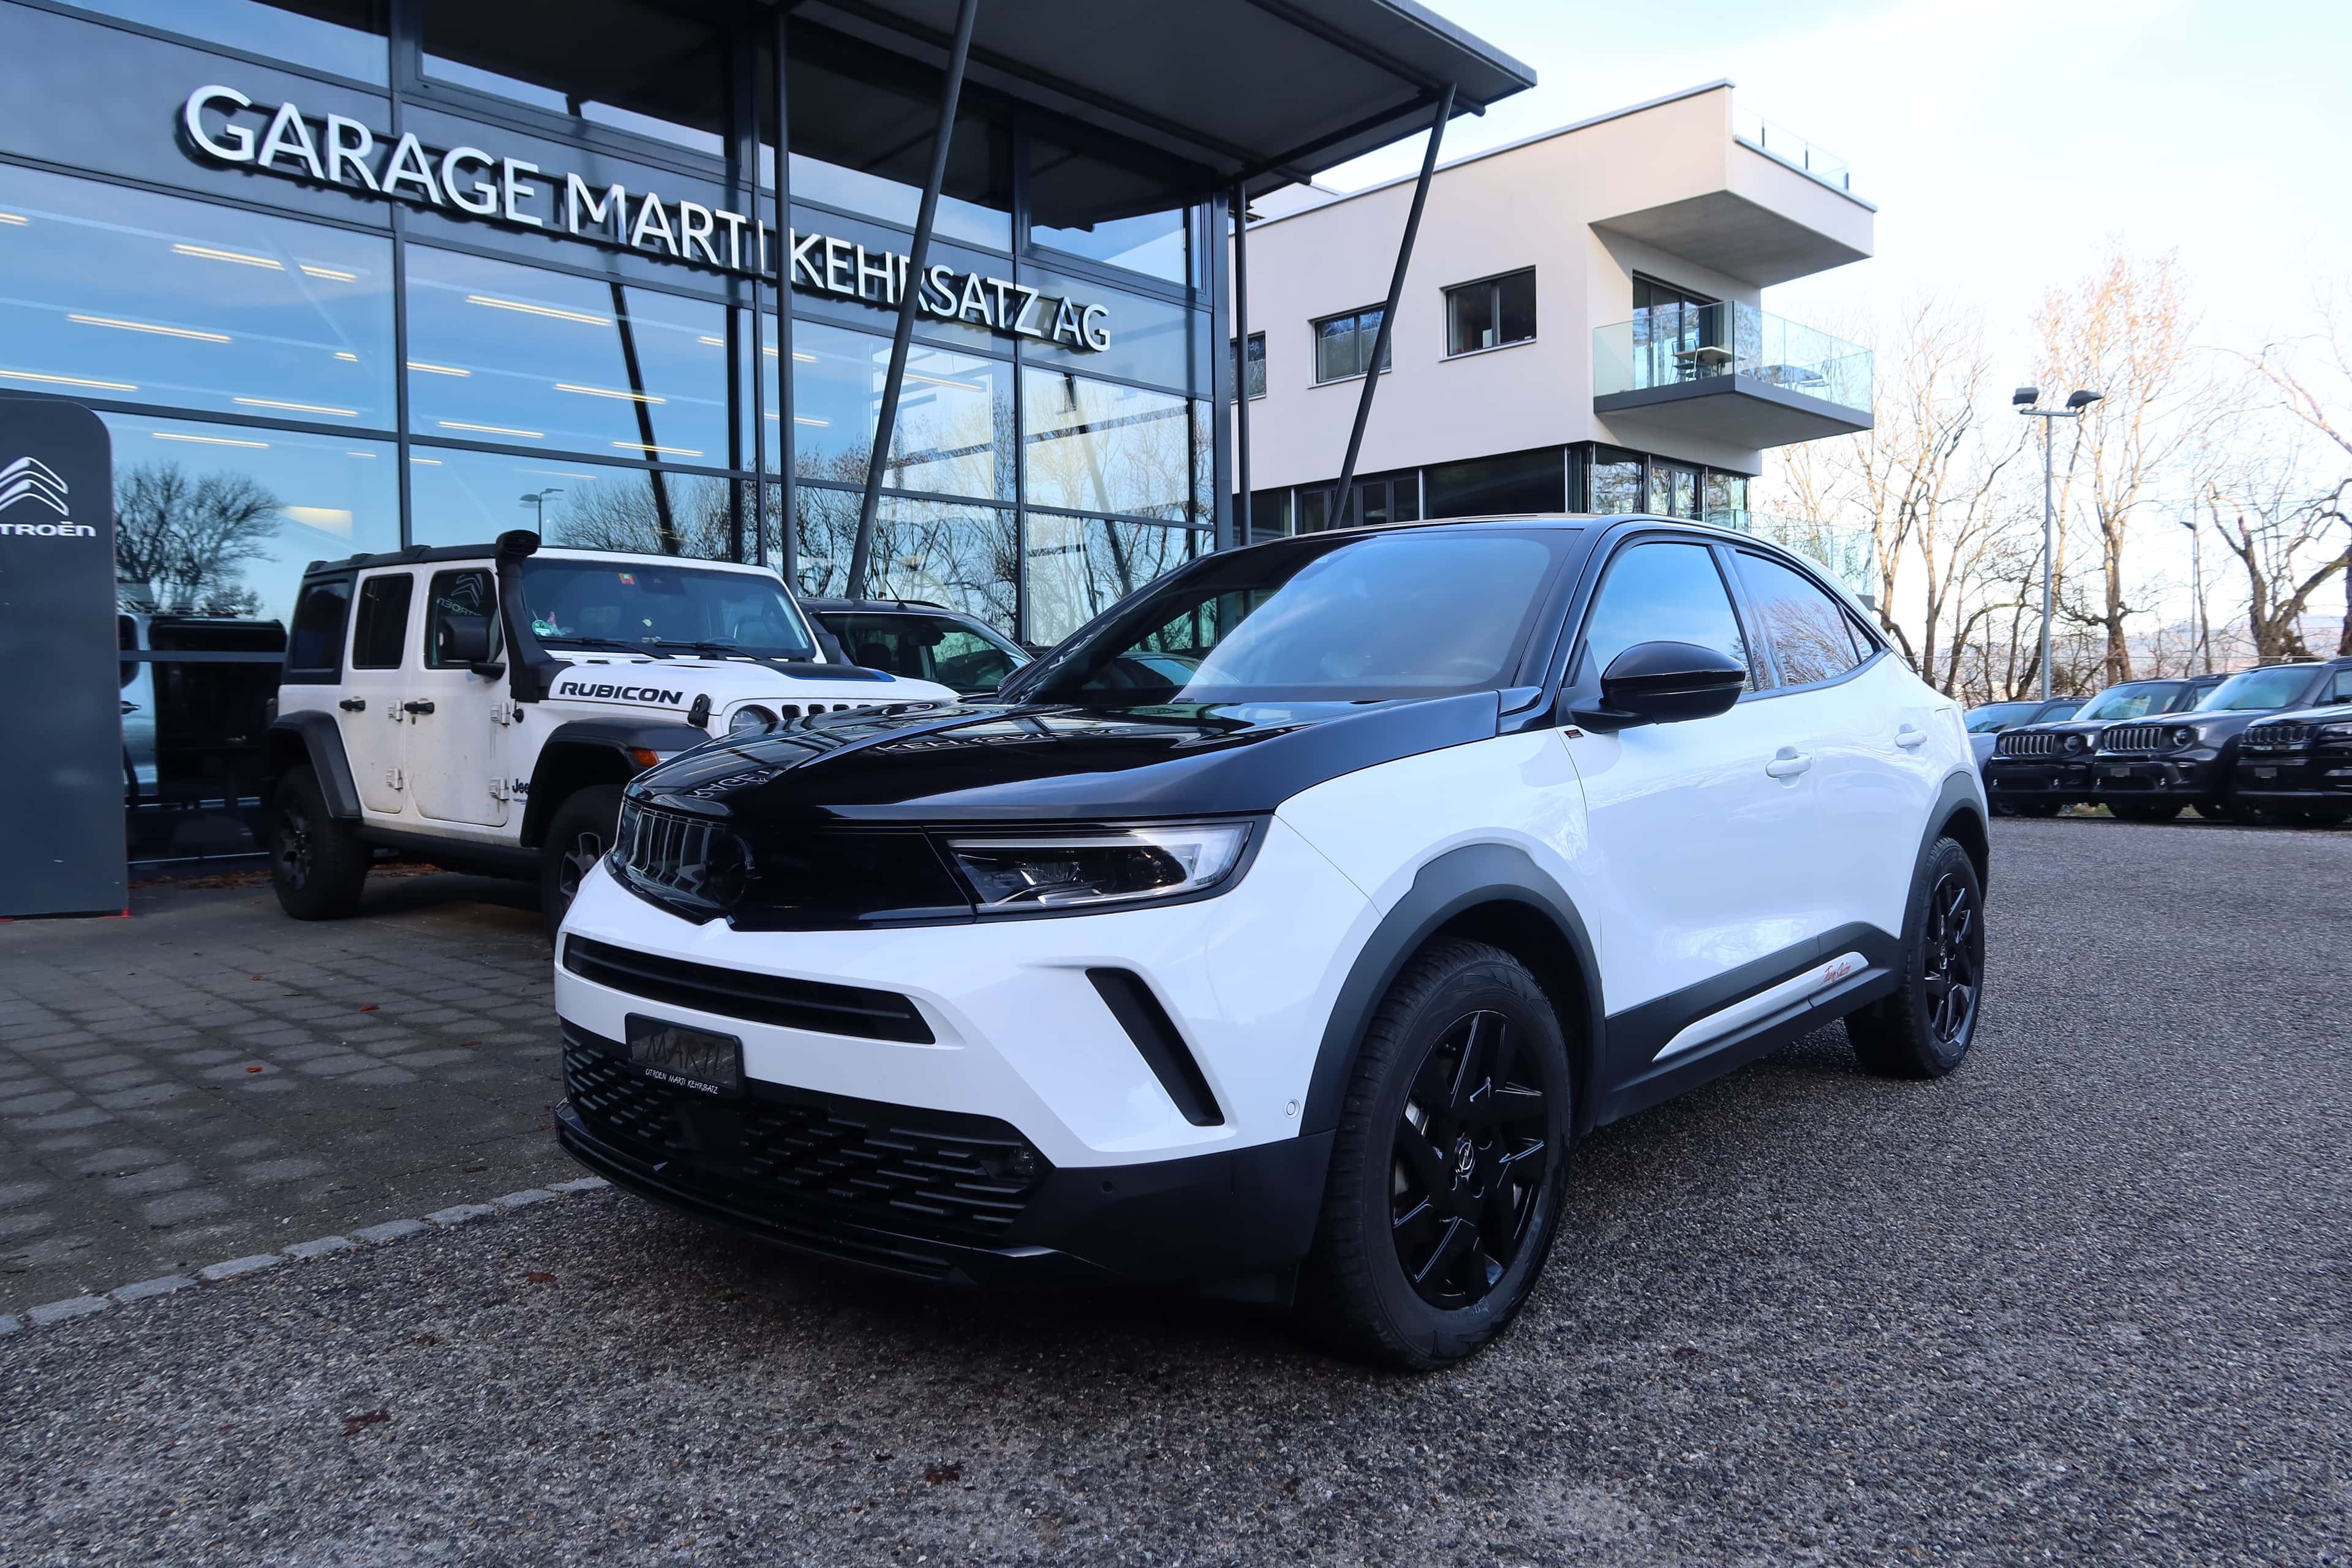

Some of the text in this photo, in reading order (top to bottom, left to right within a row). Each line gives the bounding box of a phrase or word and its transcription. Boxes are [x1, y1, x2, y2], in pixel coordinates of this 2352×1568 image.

[186, 85, 543, 227] GARAGE
[567, 172, 765, 276] MARTI
[1053, 296, 1112, 353] AG
[559, 681, 684, 705] RUBICON
[512, 778, 530, 796] Jee
[668, 1074, 686, 1087] MARTI
